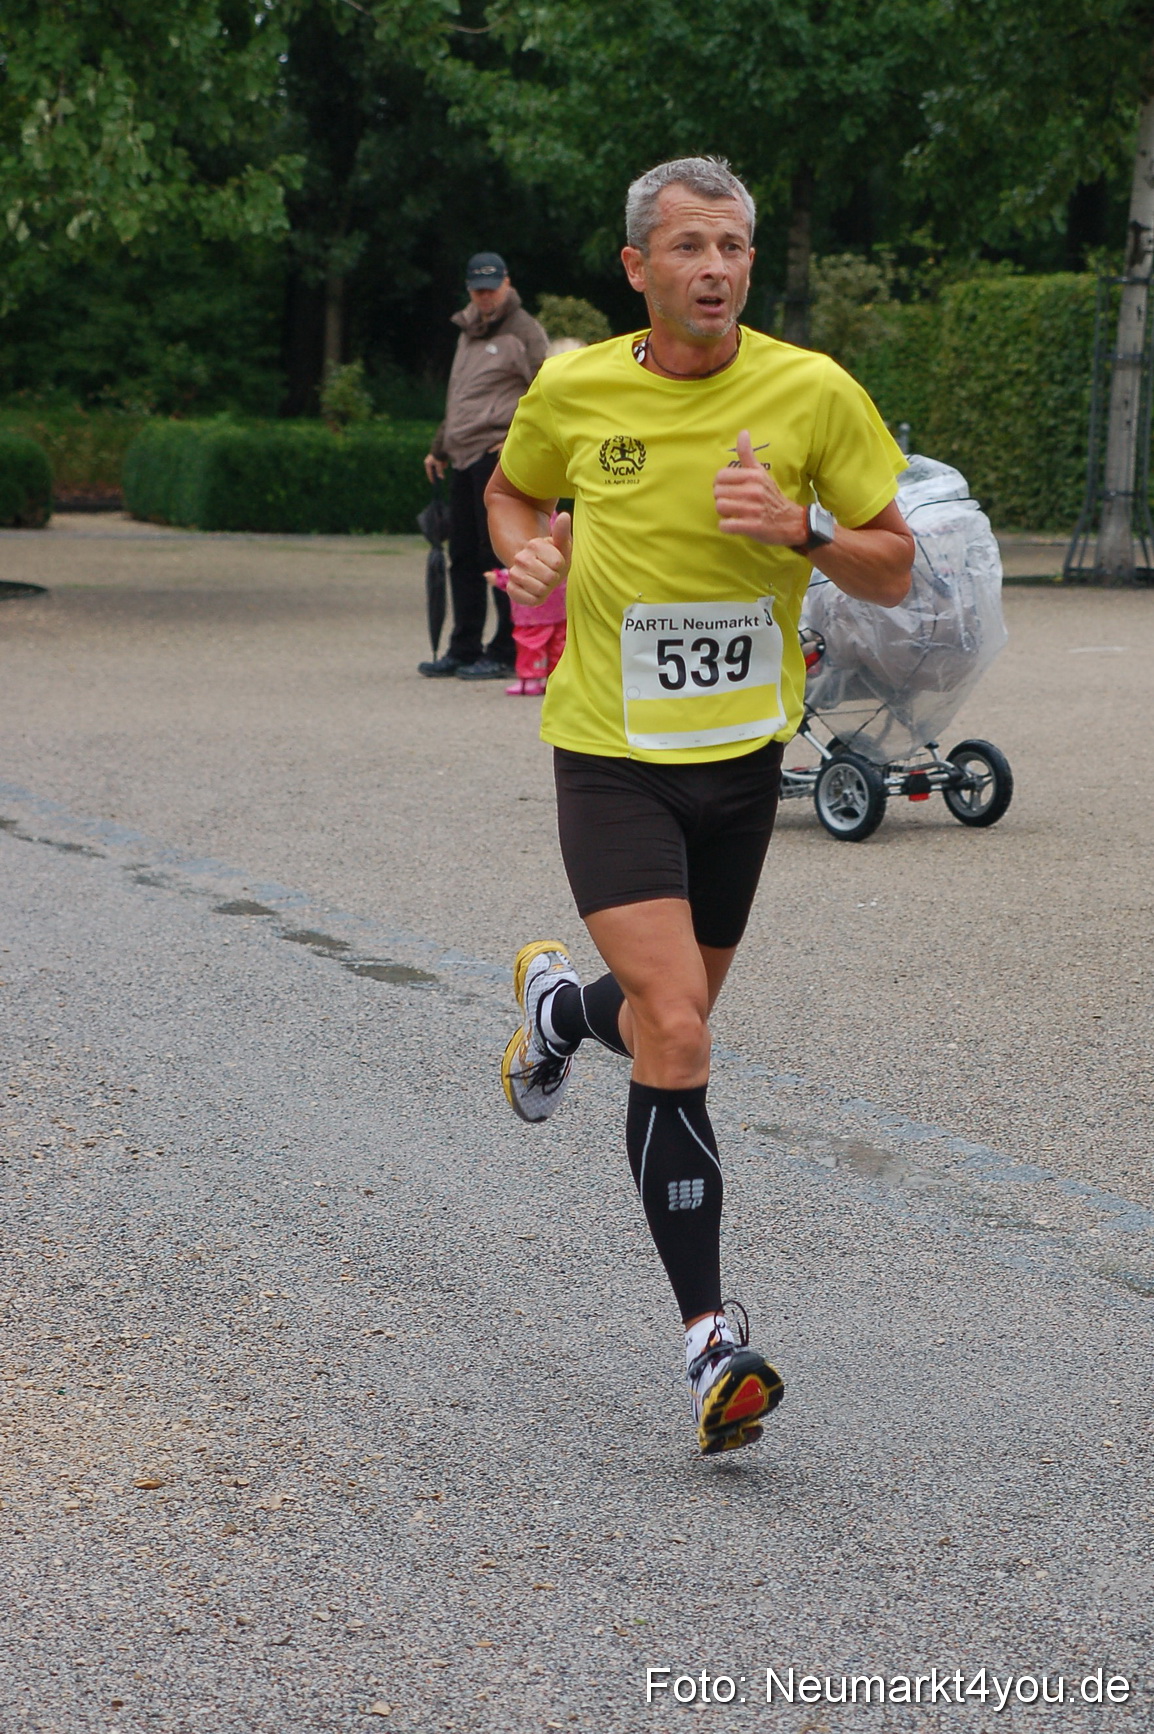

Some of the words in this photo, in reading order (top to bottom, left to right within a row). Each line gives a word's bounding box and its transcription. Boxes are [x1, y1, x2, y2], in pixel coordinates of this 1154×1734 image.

[612, 466, 635, 476] VCM
[625, 618, 679, 632] PARTL
[683, 615, 760, 631] Neumarkt
[656, 635, 753, 691] 539
[668, 1198, 703, 1211] cep
